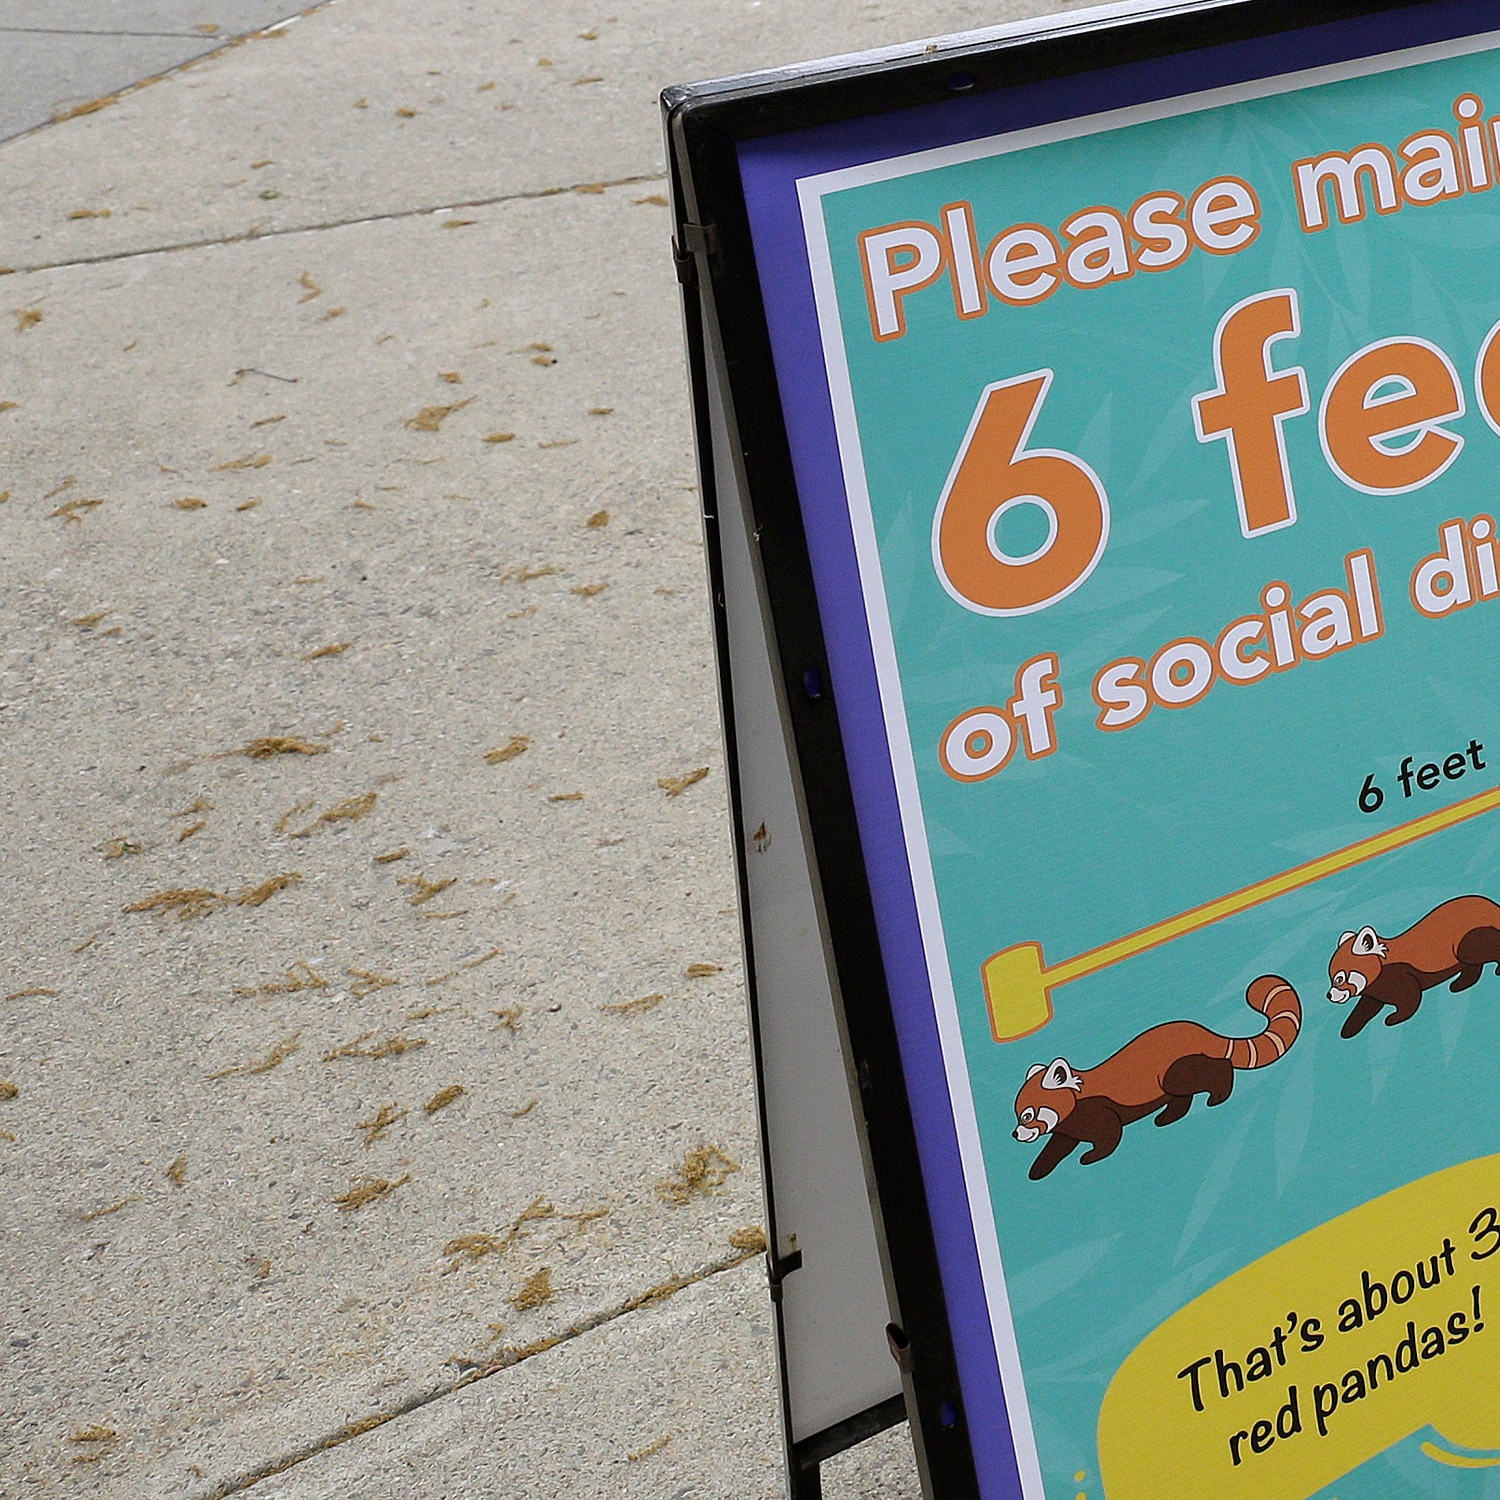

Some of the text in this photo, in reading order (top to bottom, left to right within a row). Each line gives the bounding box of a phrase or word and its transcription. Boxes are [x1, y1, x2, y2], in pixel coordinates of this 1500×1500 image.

[856, 174, 1262, 343] Please
[931, 368, 1110, 617] 6
[937, 650, 1064, 783] of
[1090, 546, 1385, 732] social
[1358, 739, 1485, 813] 6 feet
[1177, 1311, 1325, 1413] That's
[1338, 1238, 1456, 1333] about
[1229, 1285, 1484, 1466] red pandas!
